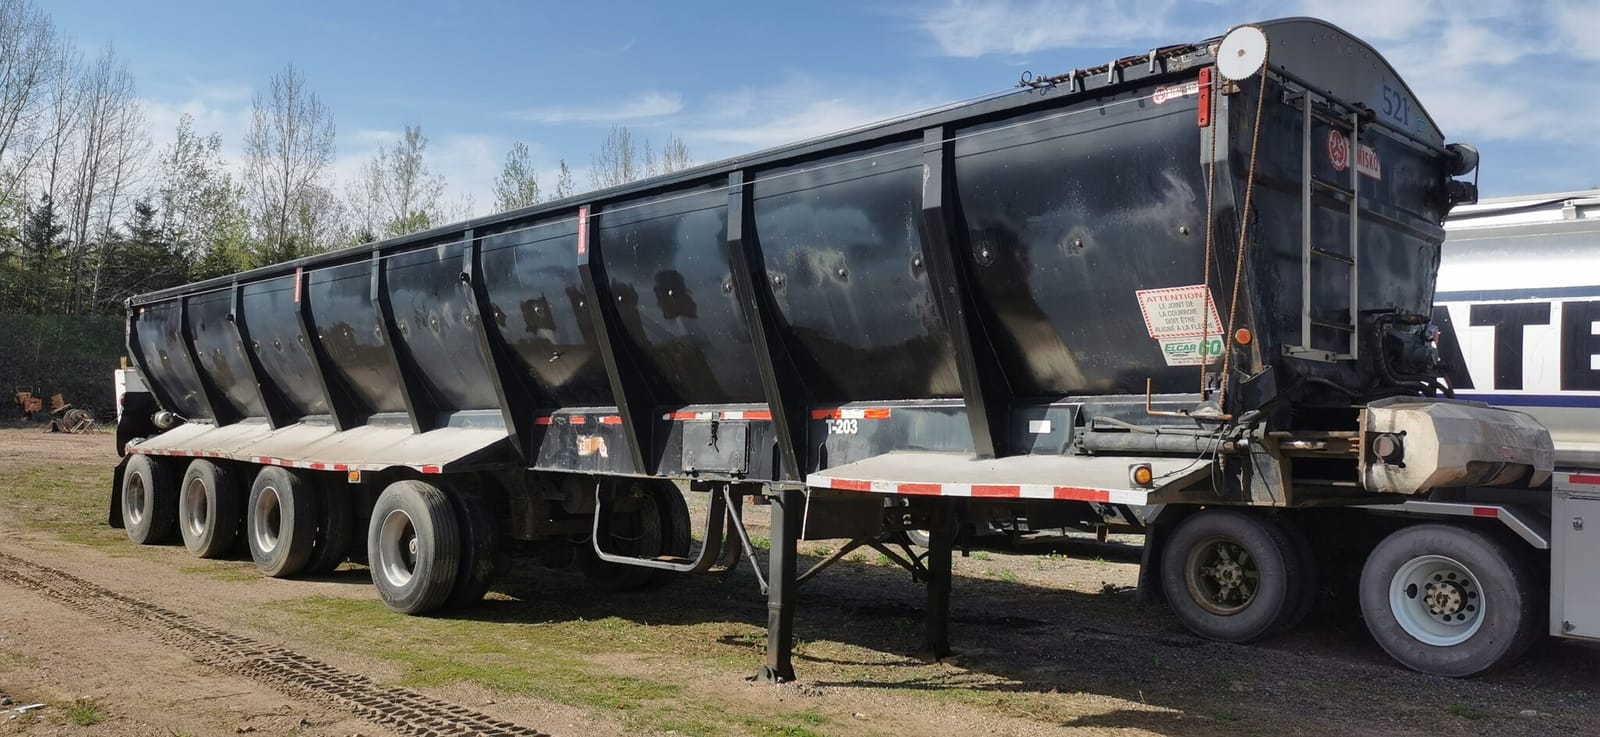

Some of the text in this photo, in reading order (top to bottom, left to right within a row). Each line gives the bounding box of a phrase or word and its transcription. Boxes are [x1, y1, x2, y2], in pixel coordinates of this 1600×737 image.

[1382, 85, 1409, 127] 521
[1146, 292, 1203, 303] ATTENTION
[1168, 301, 1185, 309] JOINT
[1185, 300, 1194, 308] DE
[1164, 343, 1197, 353] ELCAR
[825, 419, 858, 435] T-203
